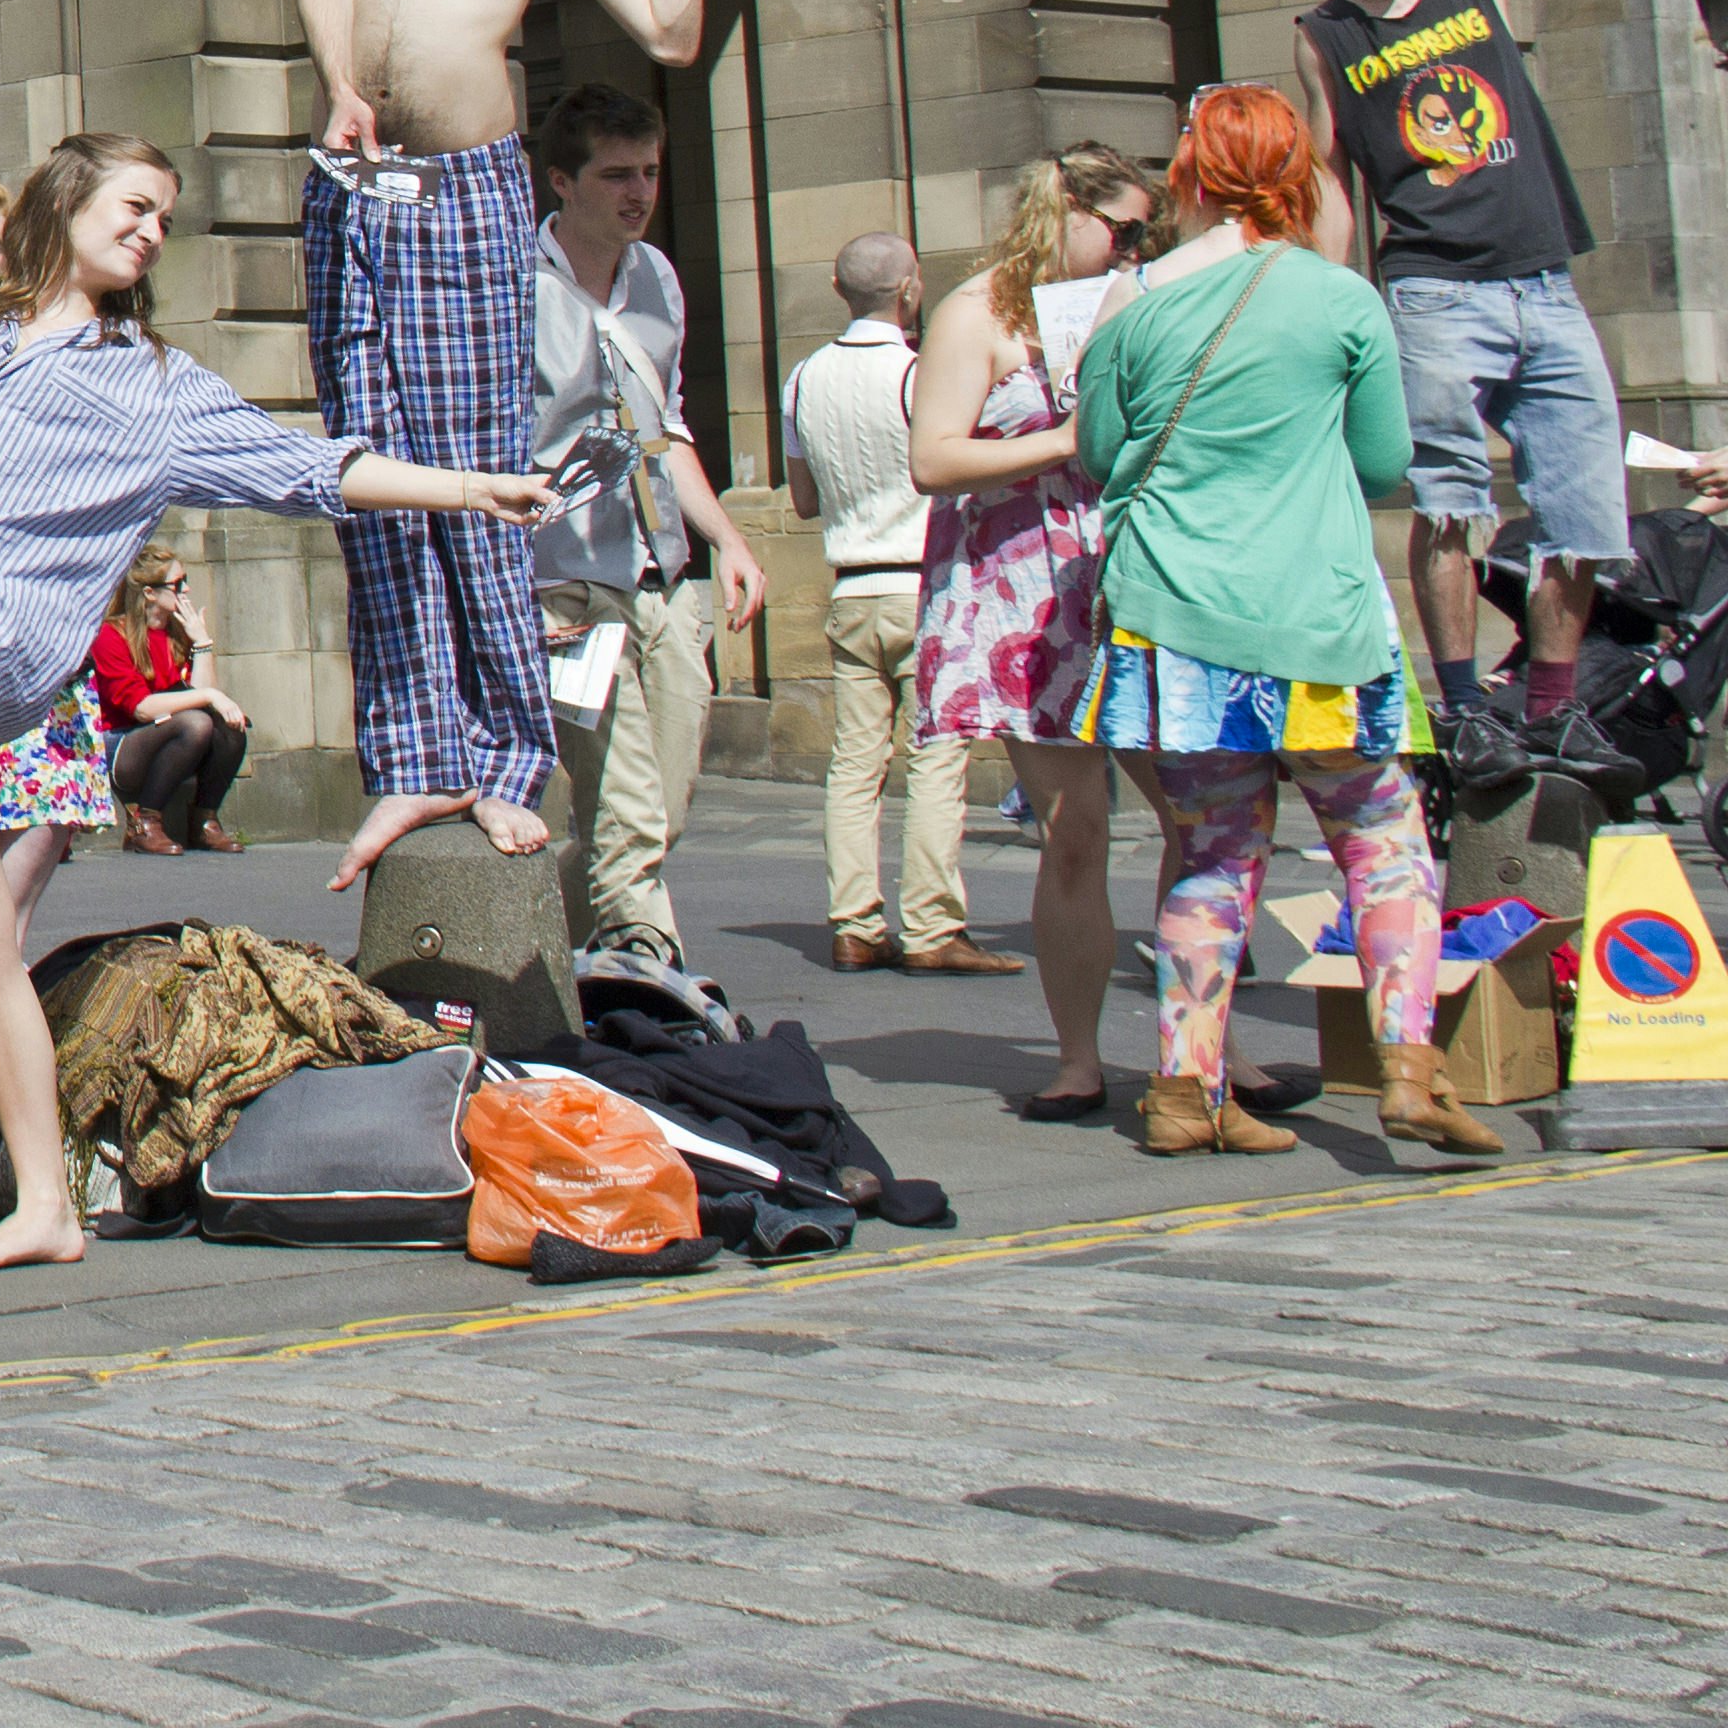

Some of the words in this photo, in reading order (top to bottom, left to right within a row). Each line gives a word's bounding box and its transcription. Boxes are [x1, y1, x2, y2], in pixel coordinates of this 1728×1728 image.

[436, 1001, 473, 1017] free
[1607, 1012, 1632, 1026] No
[1637, 1010, 1707, 1027] Loading
